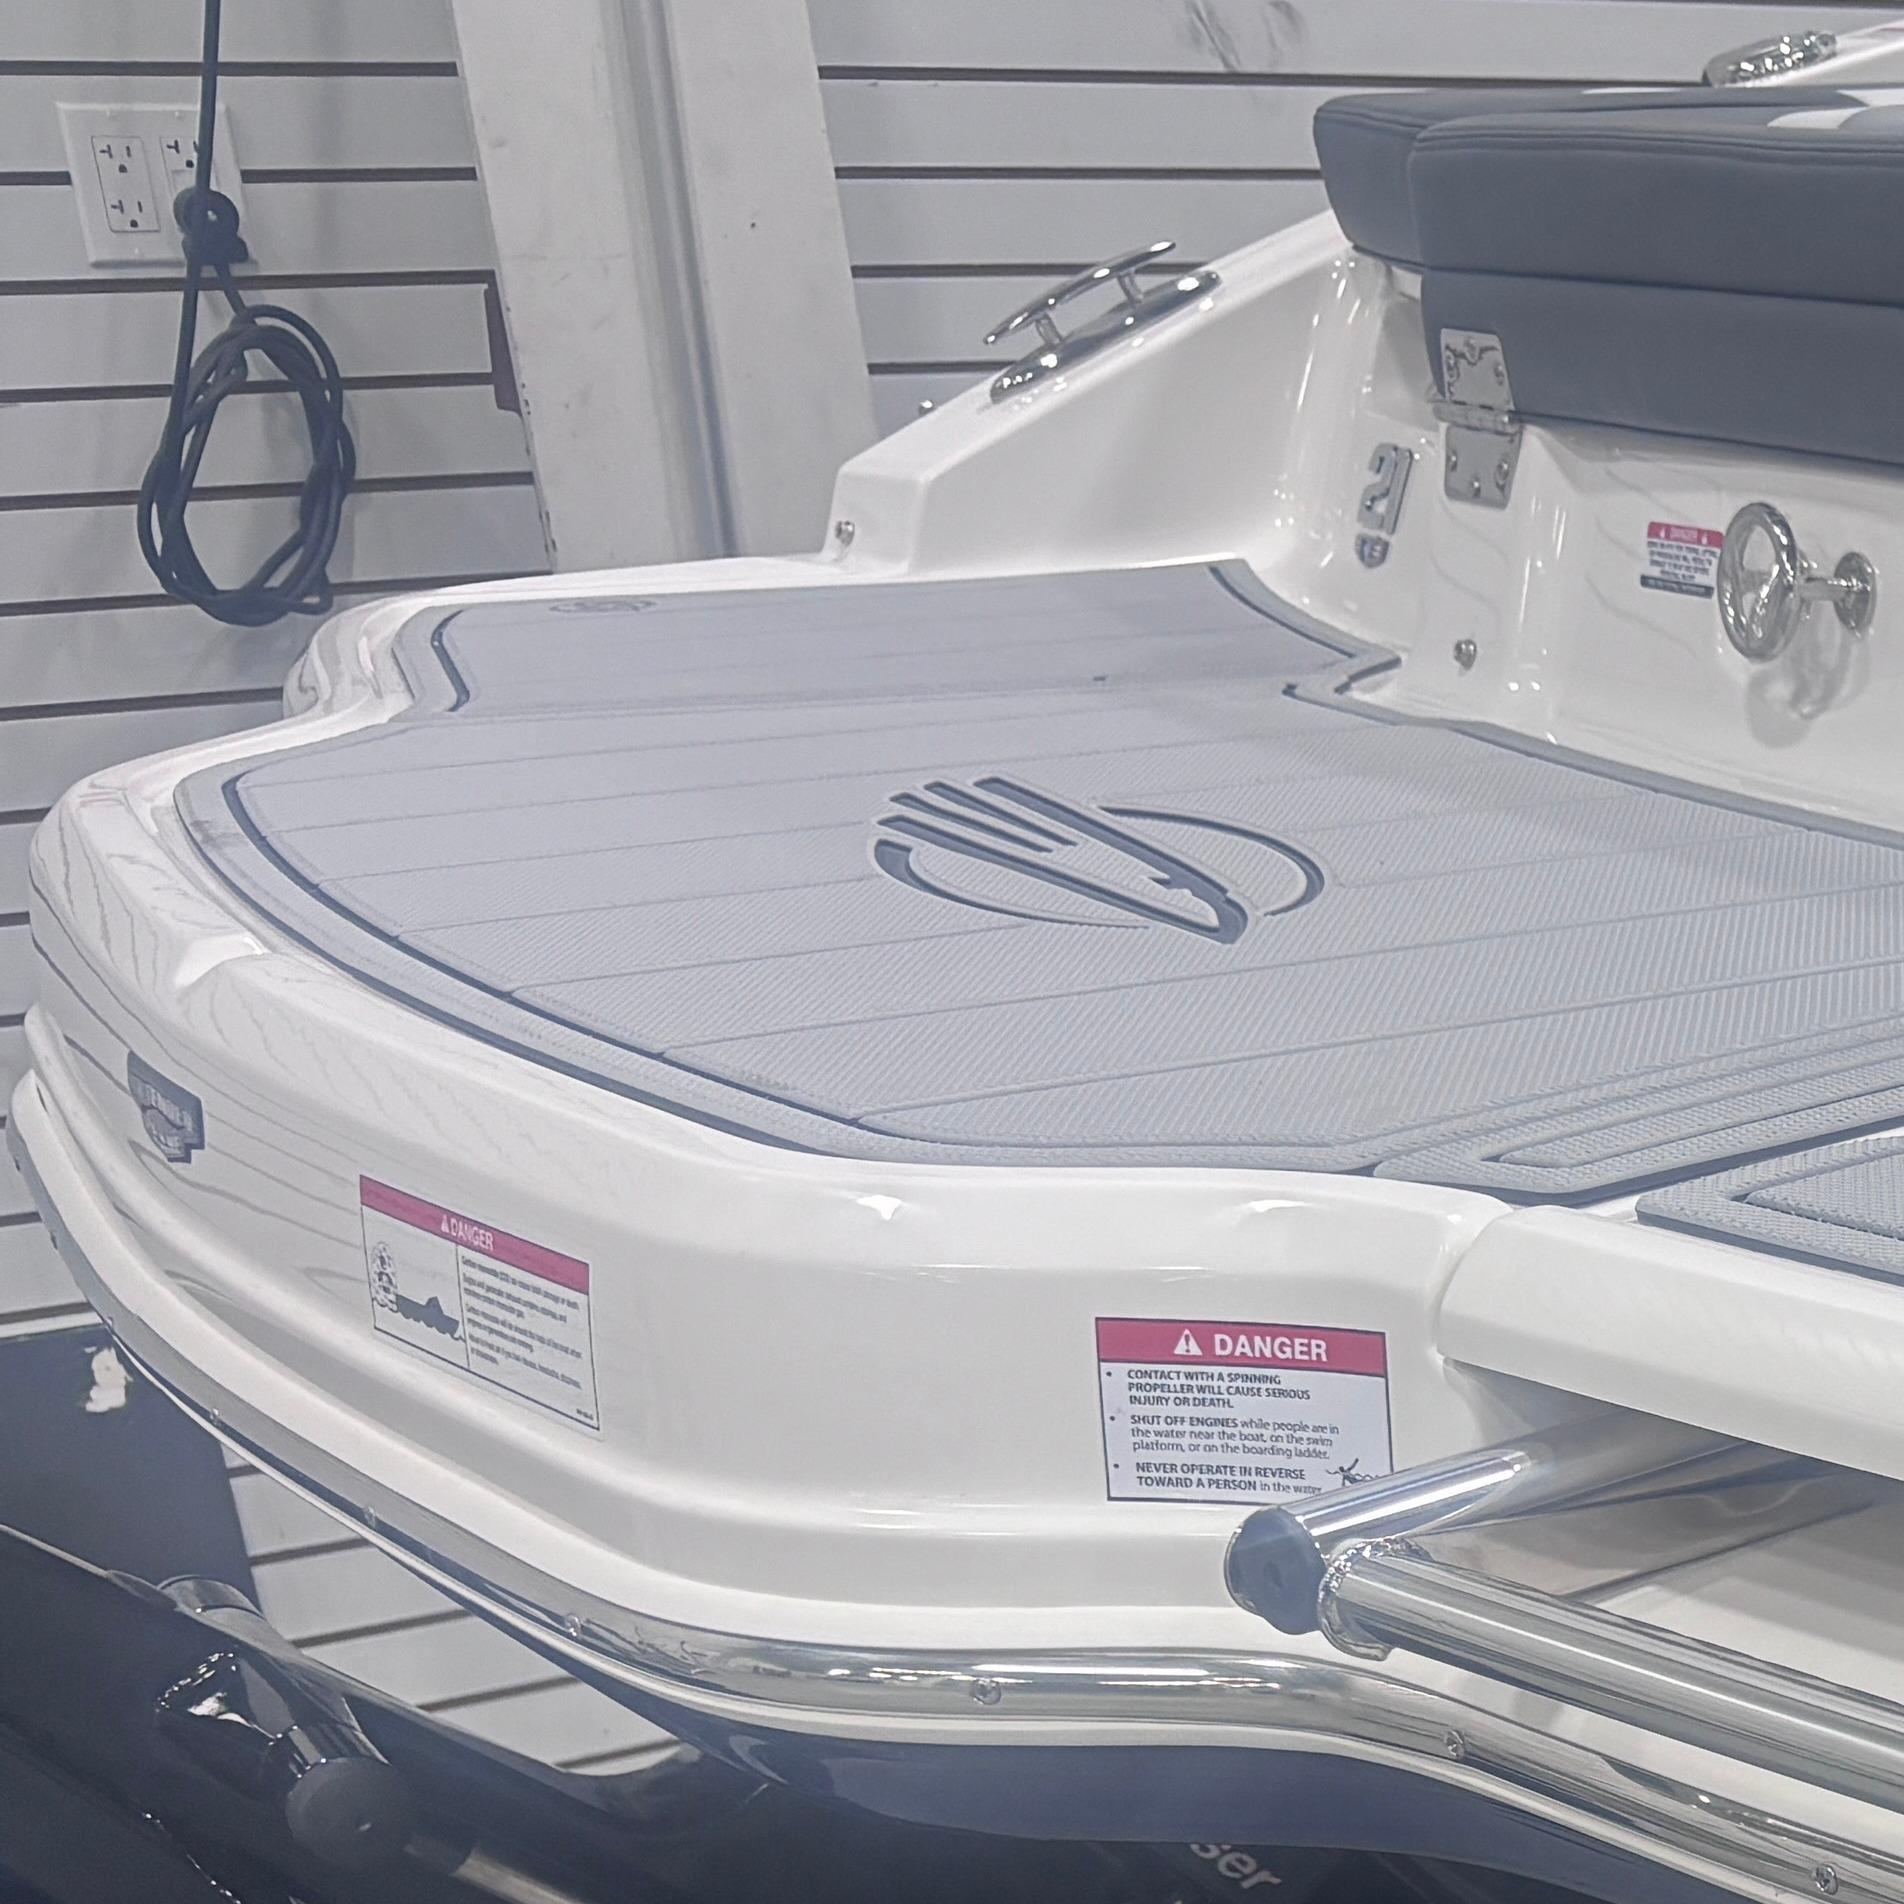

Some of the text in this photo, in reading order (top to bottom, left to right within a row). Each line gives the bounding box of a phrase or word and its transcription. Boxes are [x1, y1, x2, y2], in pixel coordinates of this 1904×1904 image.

[450, 1217, 494, 1251] DANGER
[1214, 1333, 1328, 1362] DANGER
[1127, 1369, 1281, 1385] CONTACT WITH A SPINNING
[1128, 1382, 1311, 1400] PROPELLER WILL CAUSE SERIOUS
[1129, 1395, 1170, 1406] INJURY
[1173, 1396, 1190, 1407] OR
[1130, 1414, 1339, 1435] SHUT OFF ENGINES while people are in
[1131, 1427, 1151, 1438] the
[1153, 1428, 1186, 1439] water
[1189, 1430, 1214, 1440] near
[1218, 1430, 1237, 1441] the
[1270, 1435, 1284, 1444] on
[1286, 1433, 1305, 1445] the
[1306, 1435, 1333, 1447] swim
[1188, 1443, 1200, 1453] or
[1203, 1443, 1218, 1453] on
[1221, 1442, 1240, 1454] the
[1242, 1444, 1292, 1459] boarding
[1136, 1462, 1306, 1480] NEVER OPERATE IN REVERSE
[1136, 1476, 1193, 1488] TOWARD
[1196, 1478, 1205, 1488] A
[1207, 1479, 1256, 1491] PERSON
[1260, 1481, 1270, 1491] in
[1272, 1482, 1291, 1493] the
